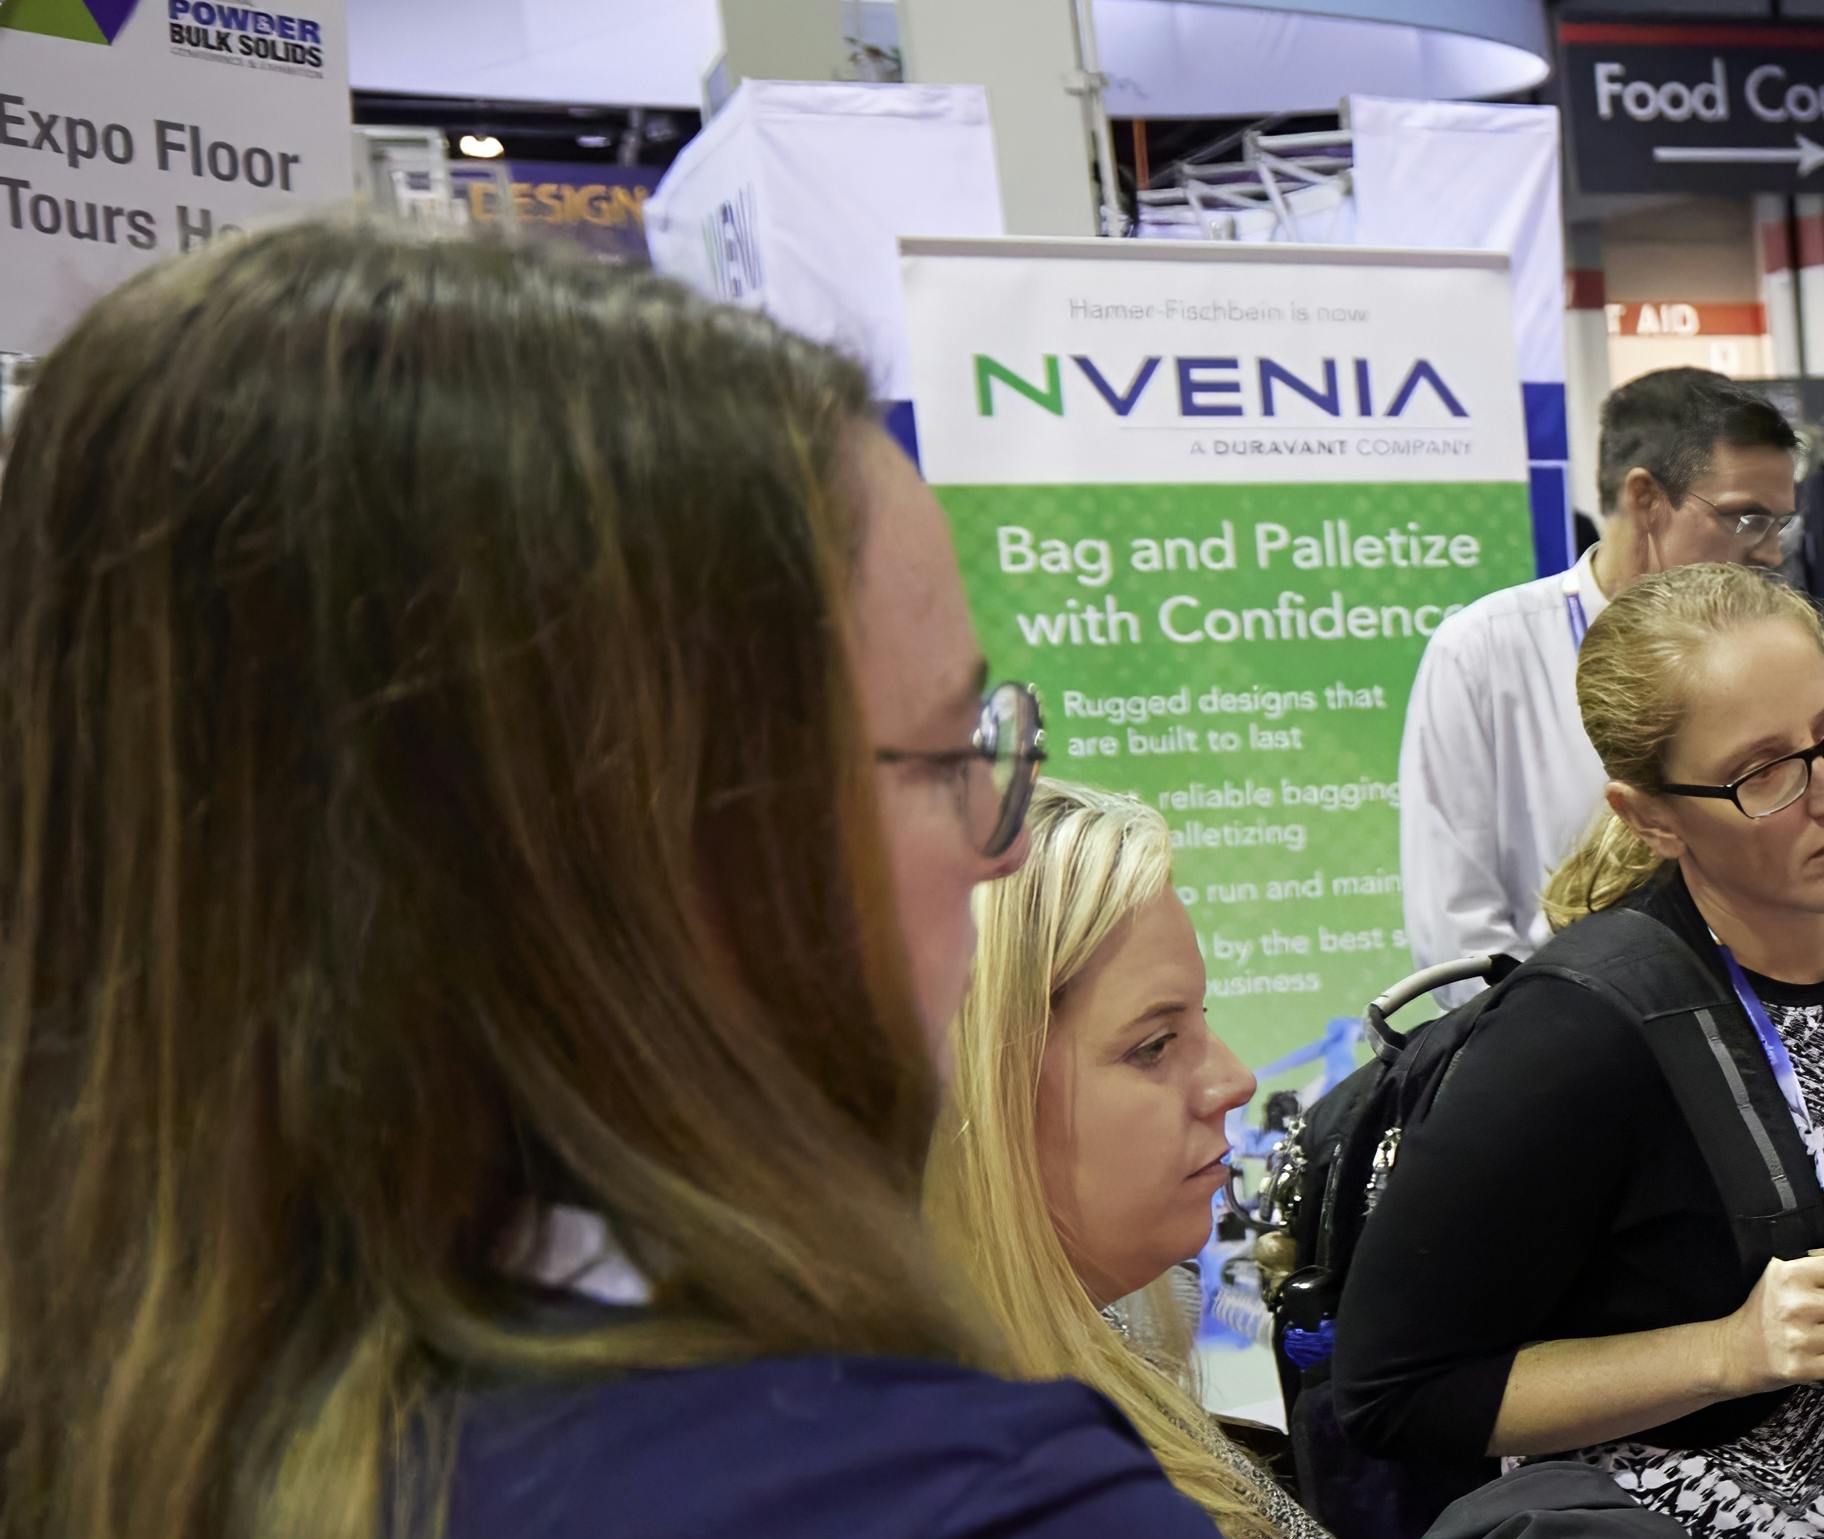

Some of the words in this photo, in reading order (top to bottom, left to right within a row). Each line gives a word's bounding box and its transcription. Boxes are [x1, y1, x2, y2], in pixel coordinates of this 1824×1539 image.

[169, 22, 233, 53] BULK
[239, 34, 323, 68] SOLIDS
[1594, 57, 1728, 122] Food
[0, 93, 134, 169] Expo
[154, 118, 302, 192] Floor
[0, 176, 157, 251] Tours
[176, 205, 245, 253] H
[1069, 299, 1282, 323] Hamer-Fischbein
[1290, 303, 1309, 322] is
[1316, 308, 1371, 323] now
[1636, 303, 1701, 337] AID
[973, 354, 1471, 418] NVENIA
[1190, 440, 1206, 455] A
[1212, 440, 1348, 456] DURAVANT
[1355, 439, 1473, 456] COMPANY
[996, 524, 1115, 586] Bag
[1130, 519, 1236, 571] and
[1255, 518, 1481, 571] Palletize
[1016, 599, 1140, 646] with
[1158, 587, 1466, 644] Confidenc
[1063, 689, 1189, 726] Rugged
[1199, 684, 1318, 721] designs
[1324, 682, 1387, 710] that
[1067, 733, 1117, 758] are
[1126, 727, 1199, 757] built
[1207, 726, 1242, 753] to
[1249, 724, 1304, 752] last
[1157, 779, 1273, 811] reliable
[1206, 882, 1259, 903] run
[1265, 869, 1324, 900] and
[1213, 931, 1254, 966] by
[1258, 928, 1309, 956] the
[1318, 925, 1385, 953] best
